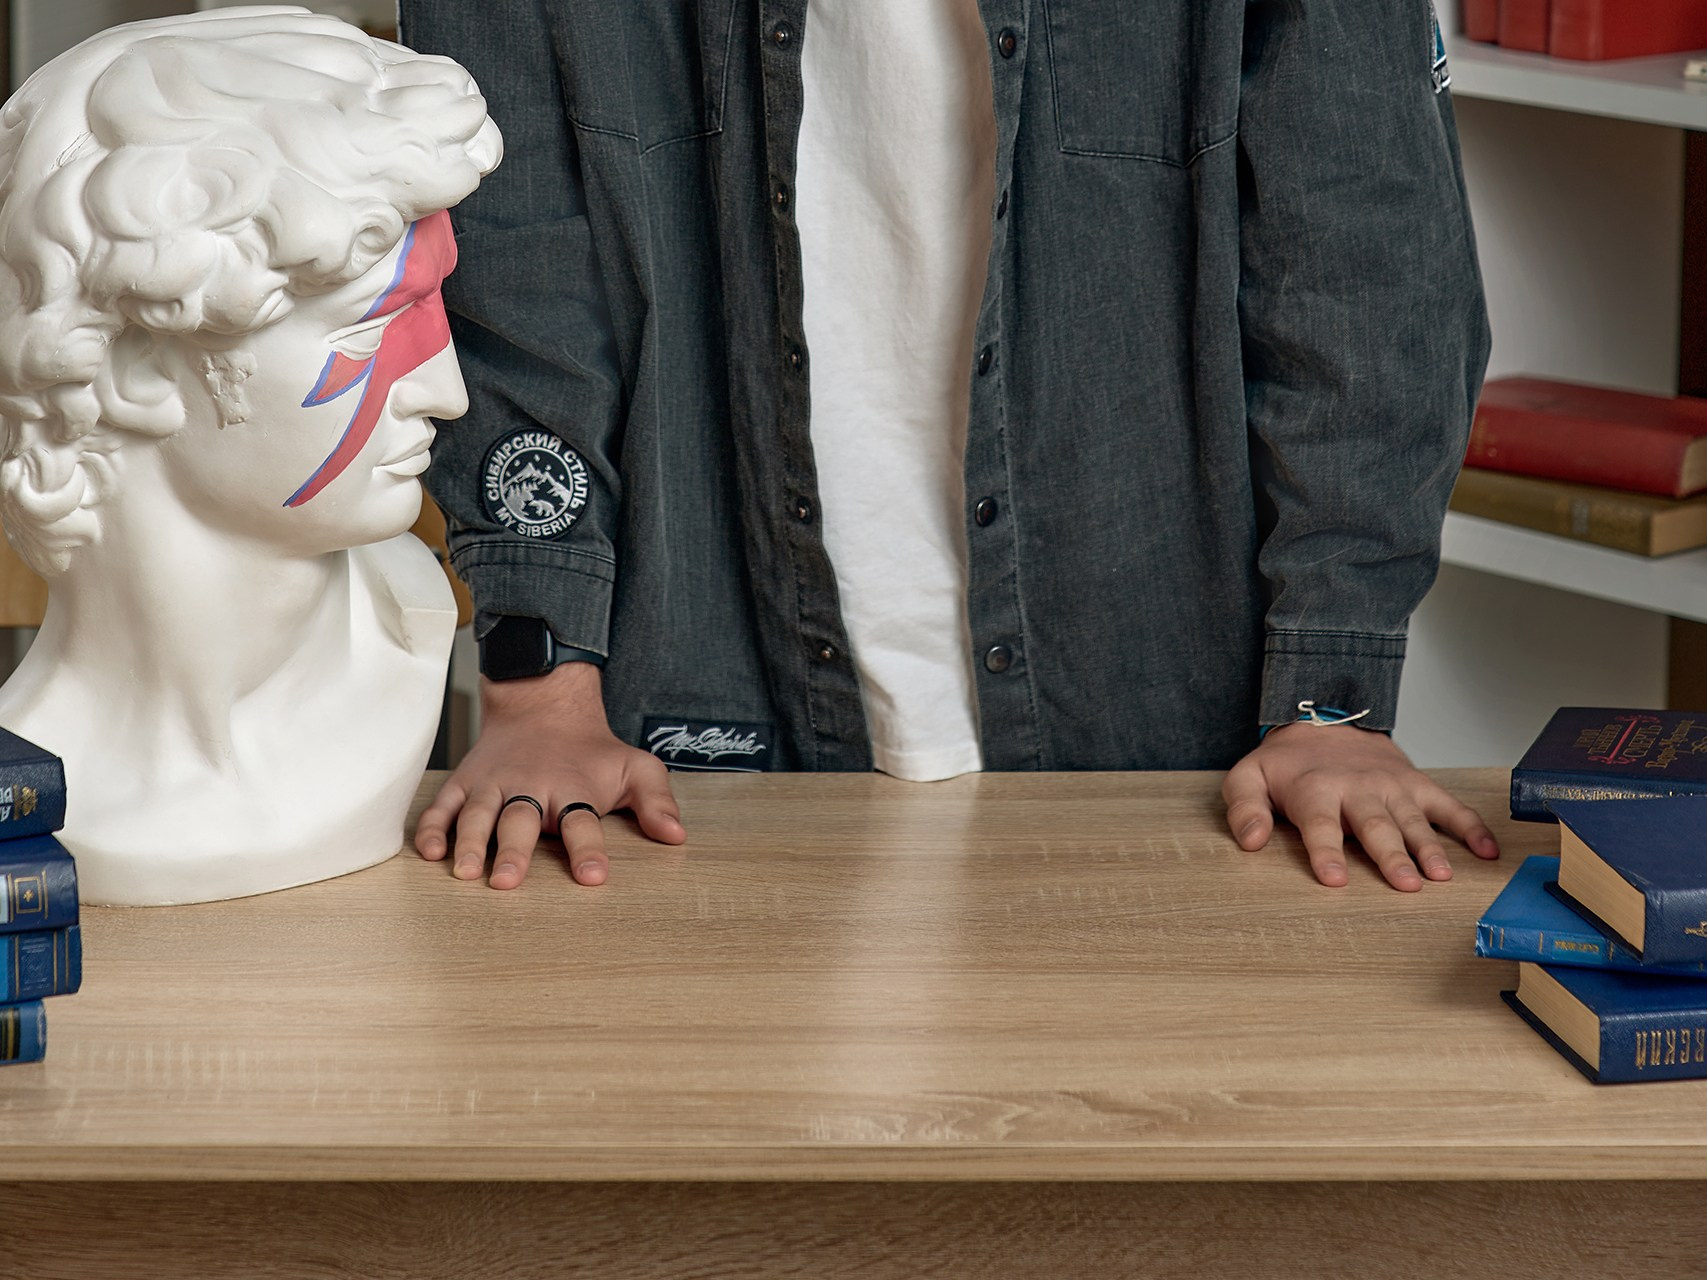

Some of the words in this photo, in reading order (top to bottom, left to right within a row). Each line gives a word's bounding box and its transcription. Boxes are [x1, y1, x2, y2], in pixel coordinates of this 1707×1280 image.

[486, 432, 563, 501] СИБИРСКИЙ
[563, 450, 589, 509] СТИЛЬ
[495, 506, 517, 528] MY
[516, 512, 577, 538] SIBERIA
